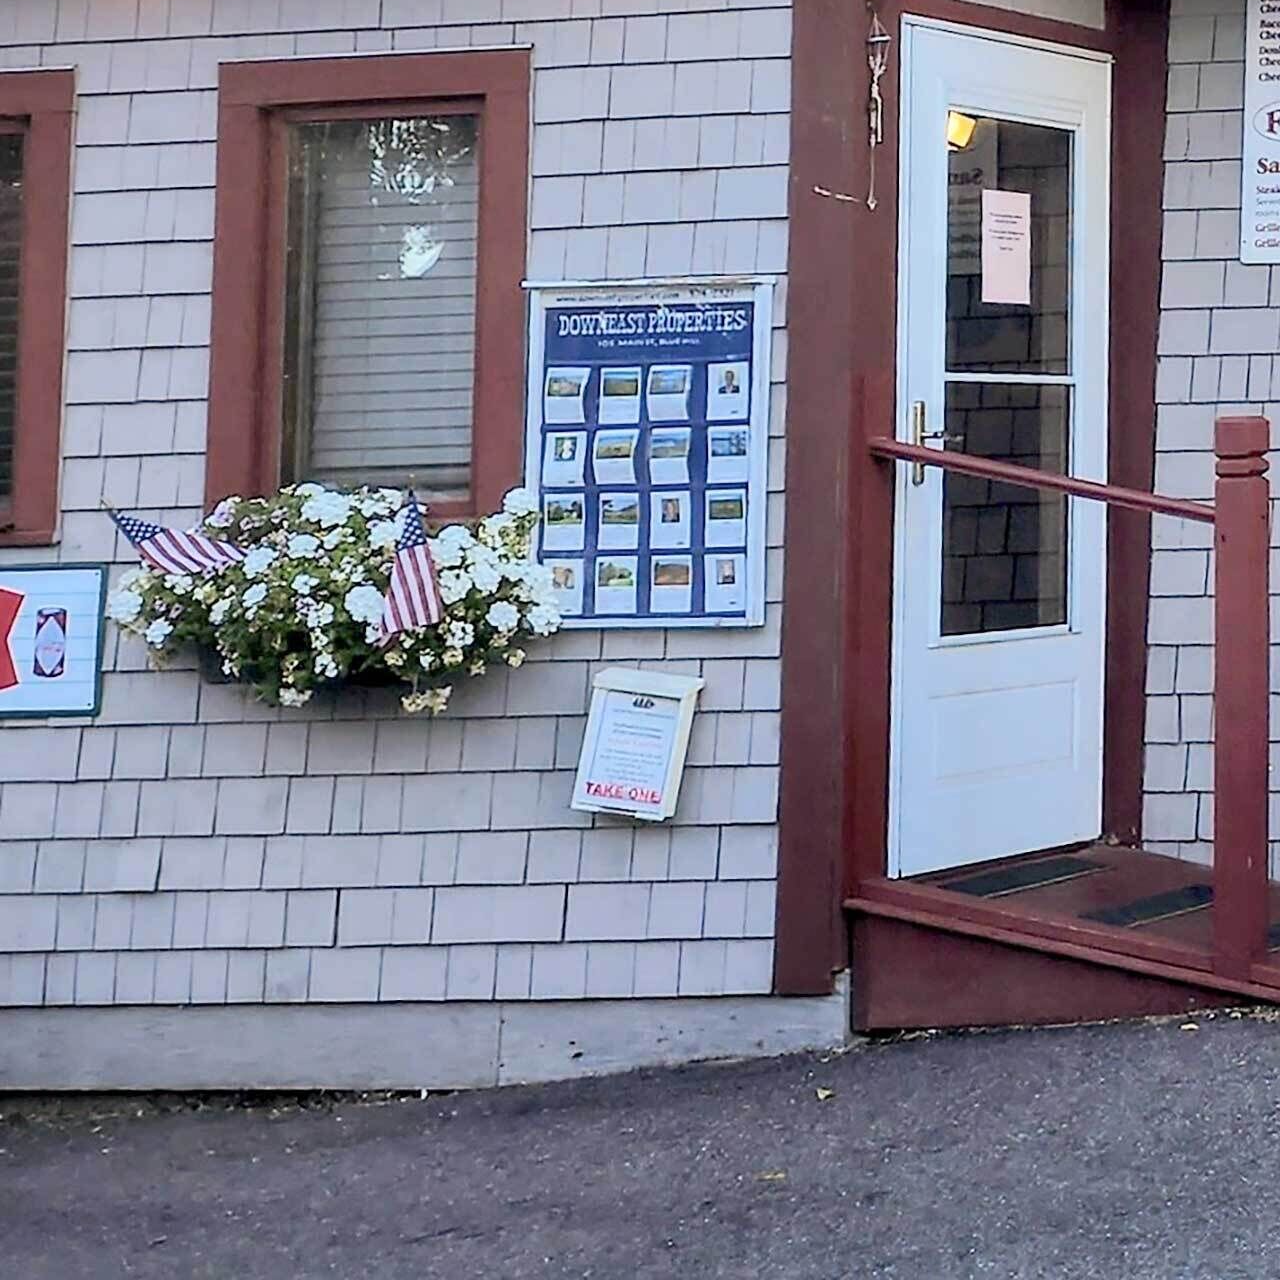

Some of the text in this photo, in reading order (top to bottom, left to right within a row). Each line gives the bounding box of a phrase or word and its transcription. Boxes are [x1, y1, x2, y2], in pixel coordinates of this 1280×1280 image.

[558, 308, 749, 337] DOWNEAST PROPERTIES
[585, 781, 664, 806] TAKE ONE
